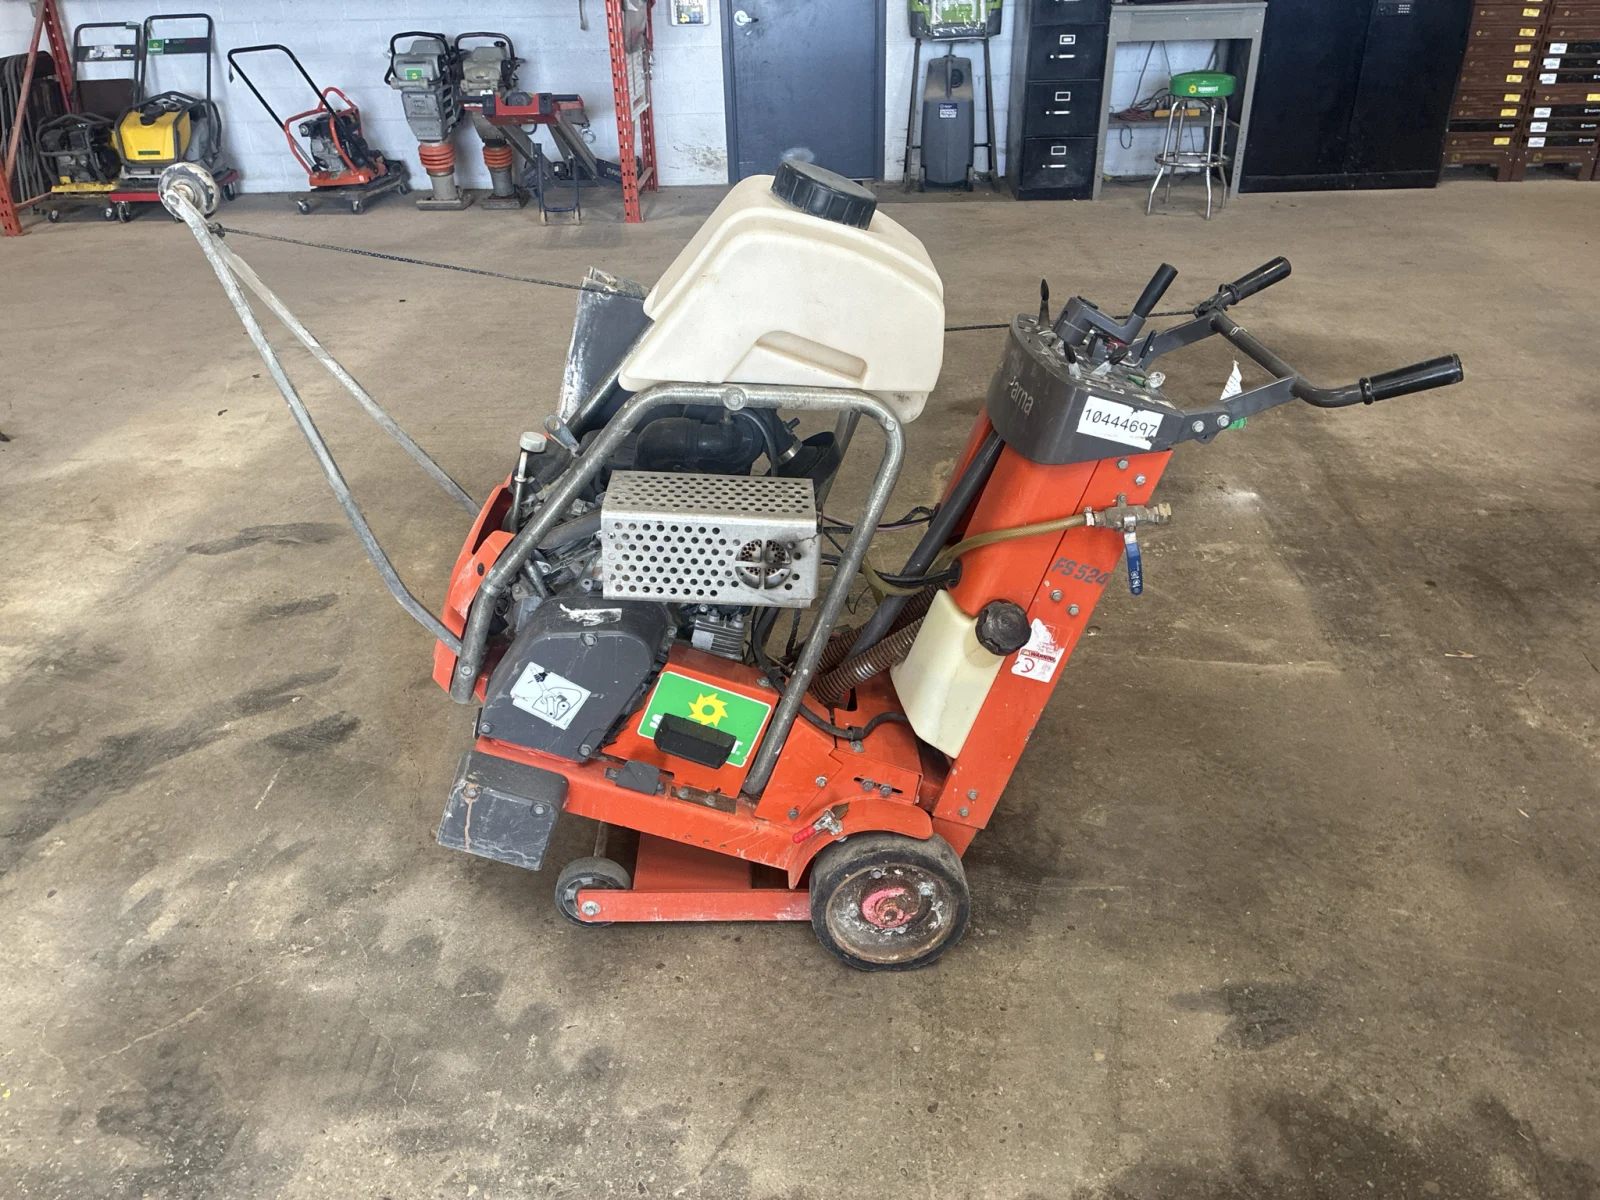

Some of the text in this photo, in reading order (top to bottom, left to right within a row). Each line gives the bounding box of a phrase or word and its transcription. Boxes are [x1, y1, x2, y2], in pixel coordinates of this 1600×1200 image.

[1085, 408, 1158, 437] 10444697
[1051, 557, 1112, 585] FS 524
